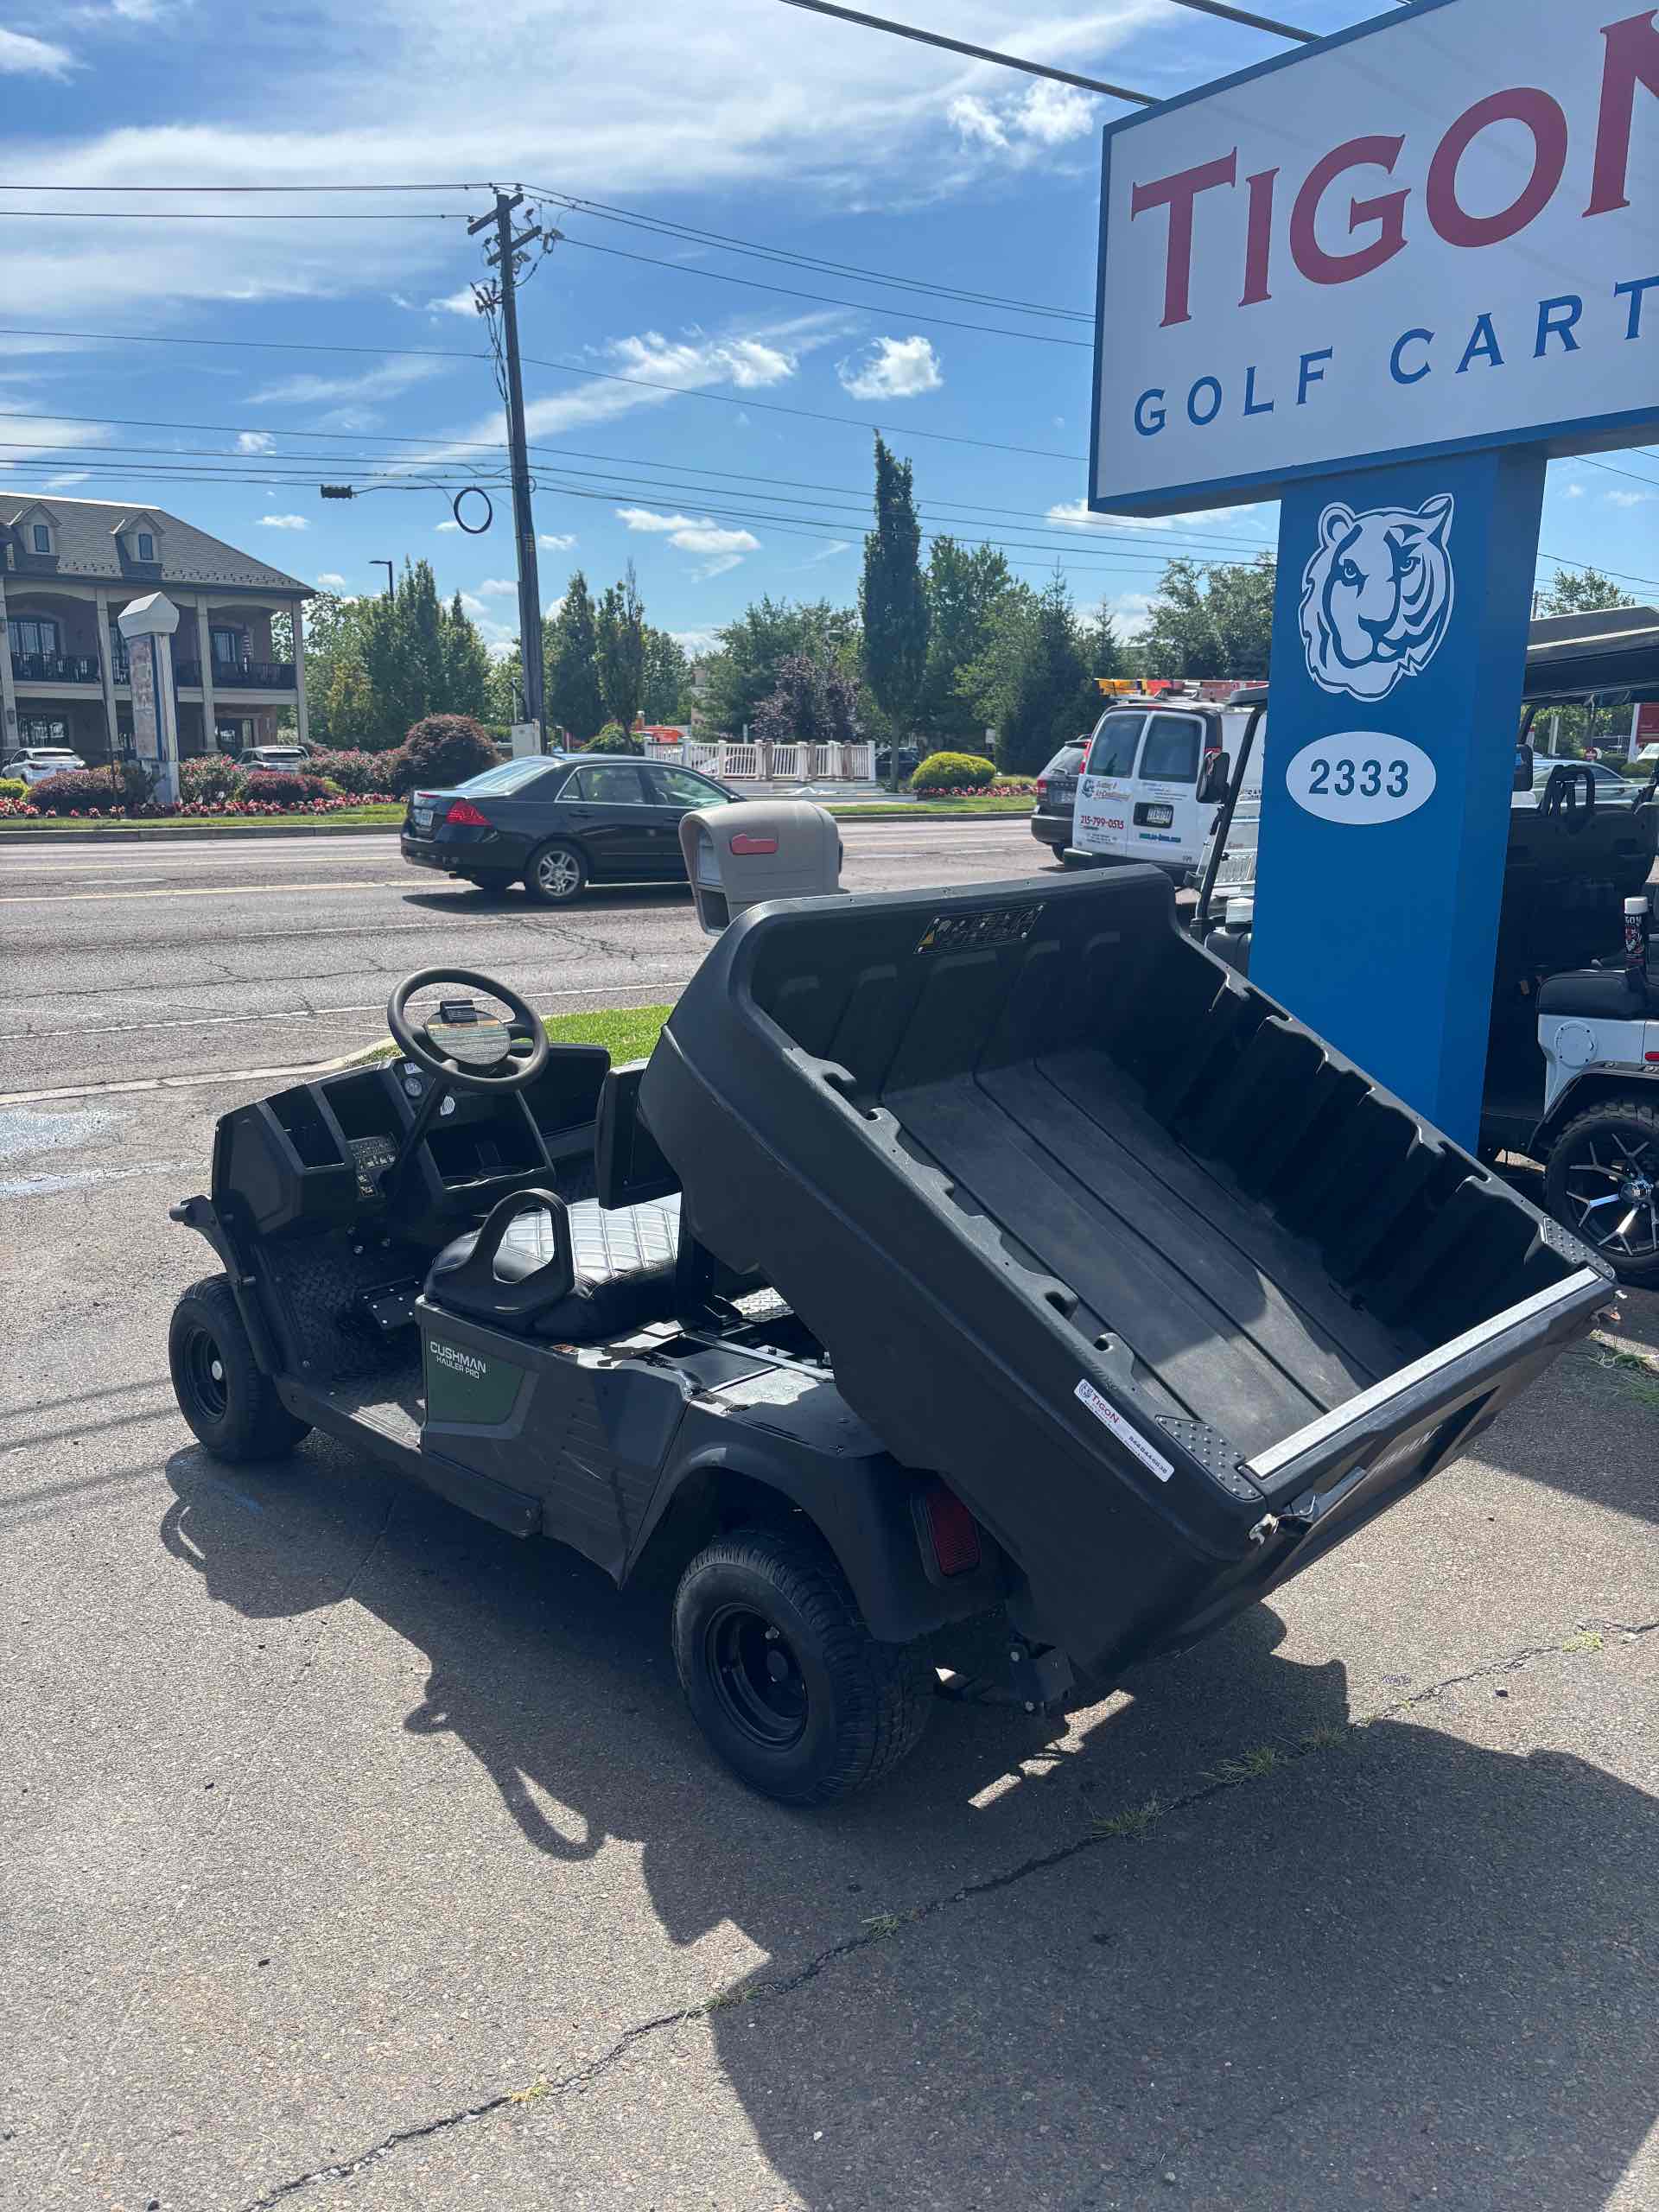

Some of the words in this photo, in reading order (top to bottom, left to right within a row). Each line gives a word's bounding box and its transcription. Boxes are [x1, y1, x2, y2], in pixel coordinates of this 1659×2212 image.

[1134, 346, 1334, 436] GOLF
[1308, 759, 1409, 798] 2333
[430, 1341, 486, 1374] CUSHMAN
[436, 1356, 464, 1372] HAULER
[465, 1367, 480, 1379] PRO
[1092, 1394, 1121, 1424] TIGON
